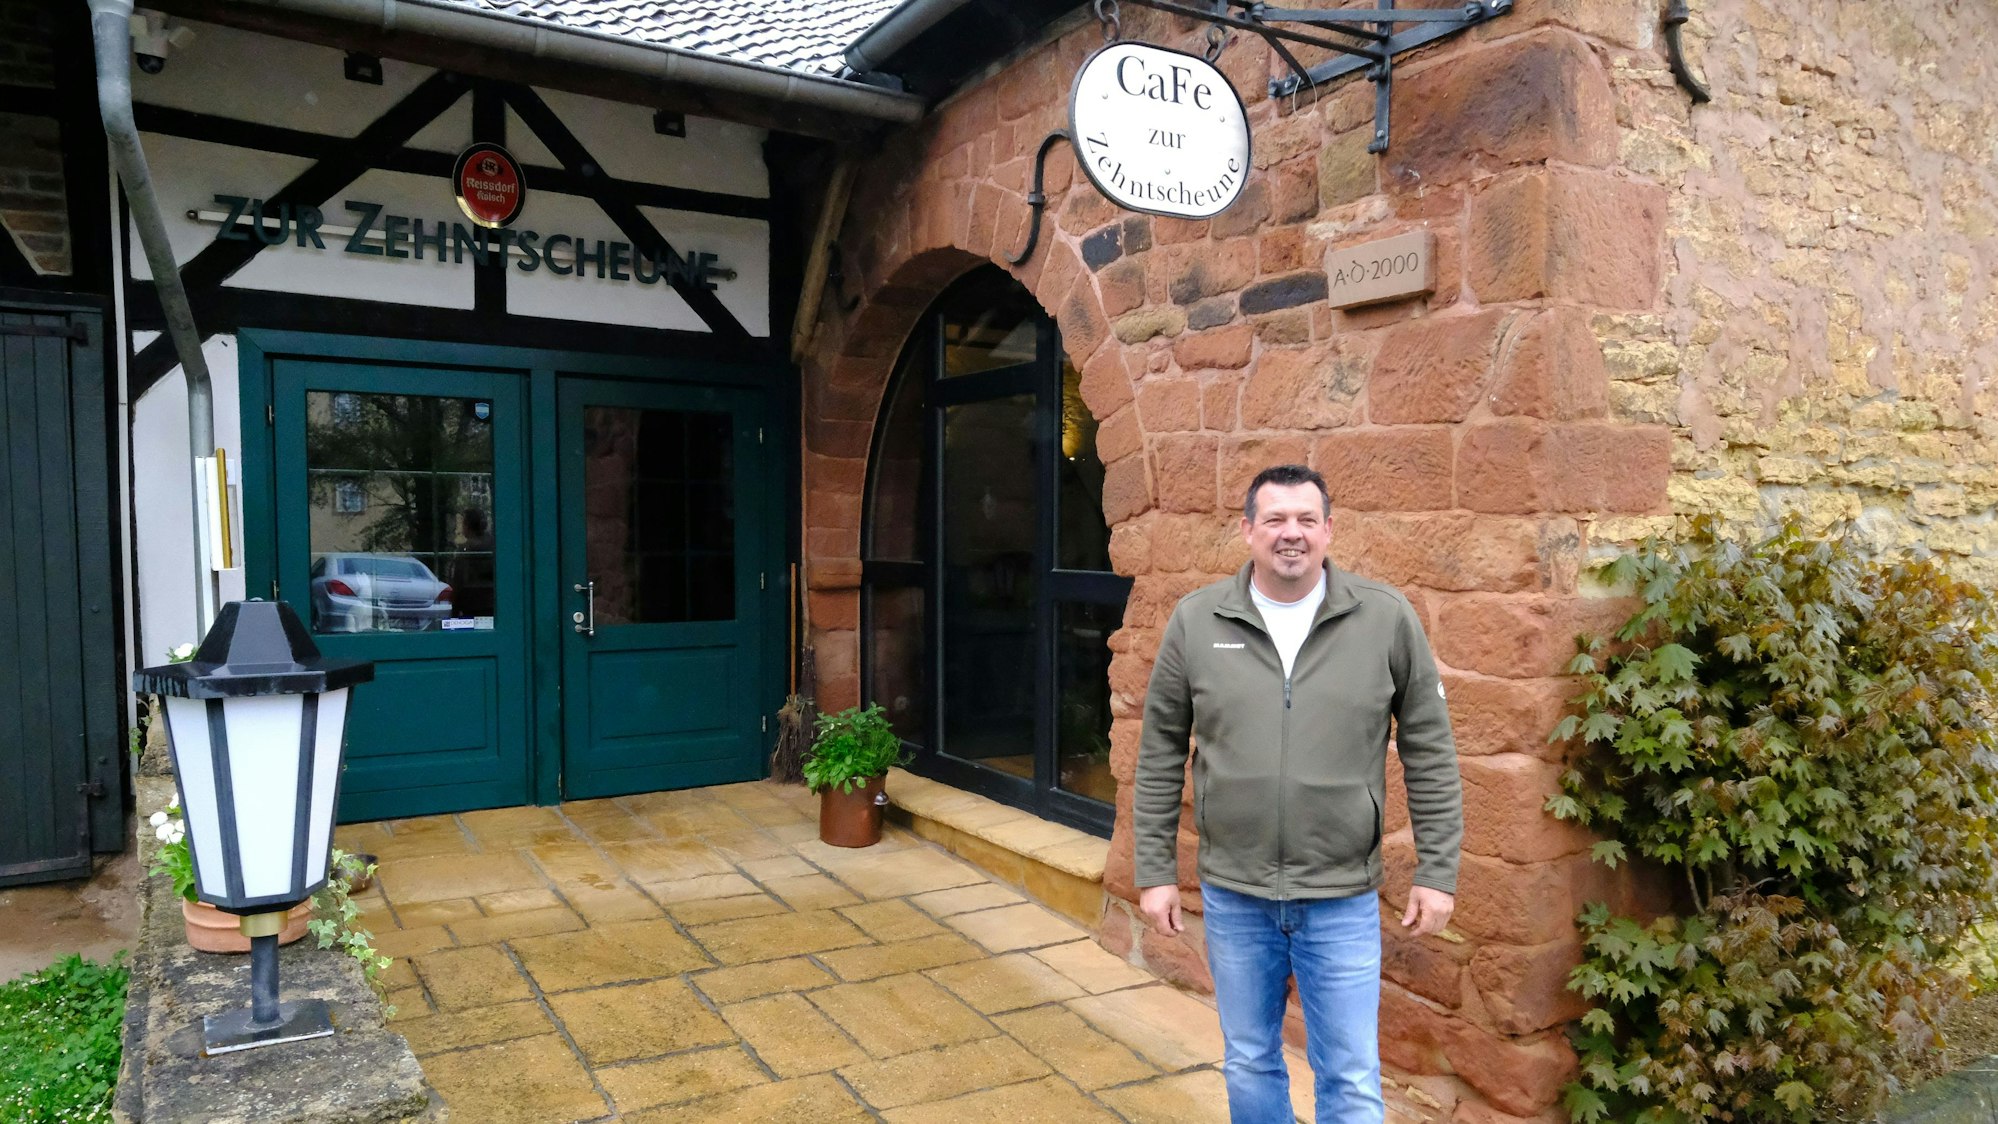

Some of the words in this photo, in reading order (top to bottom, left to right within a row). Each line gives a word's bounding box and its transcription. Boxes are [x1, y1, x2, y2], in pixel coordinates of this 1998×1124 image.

[1148, 128, 1186, 149] zur
[466, 177, 516, 194] Reissdorf
[1086, 132, 1240, 207] Zehntscheune
[214, 194, 326, 249] ZUR
[344, 200, 718, 291] ZEHNTSCHEUNE
